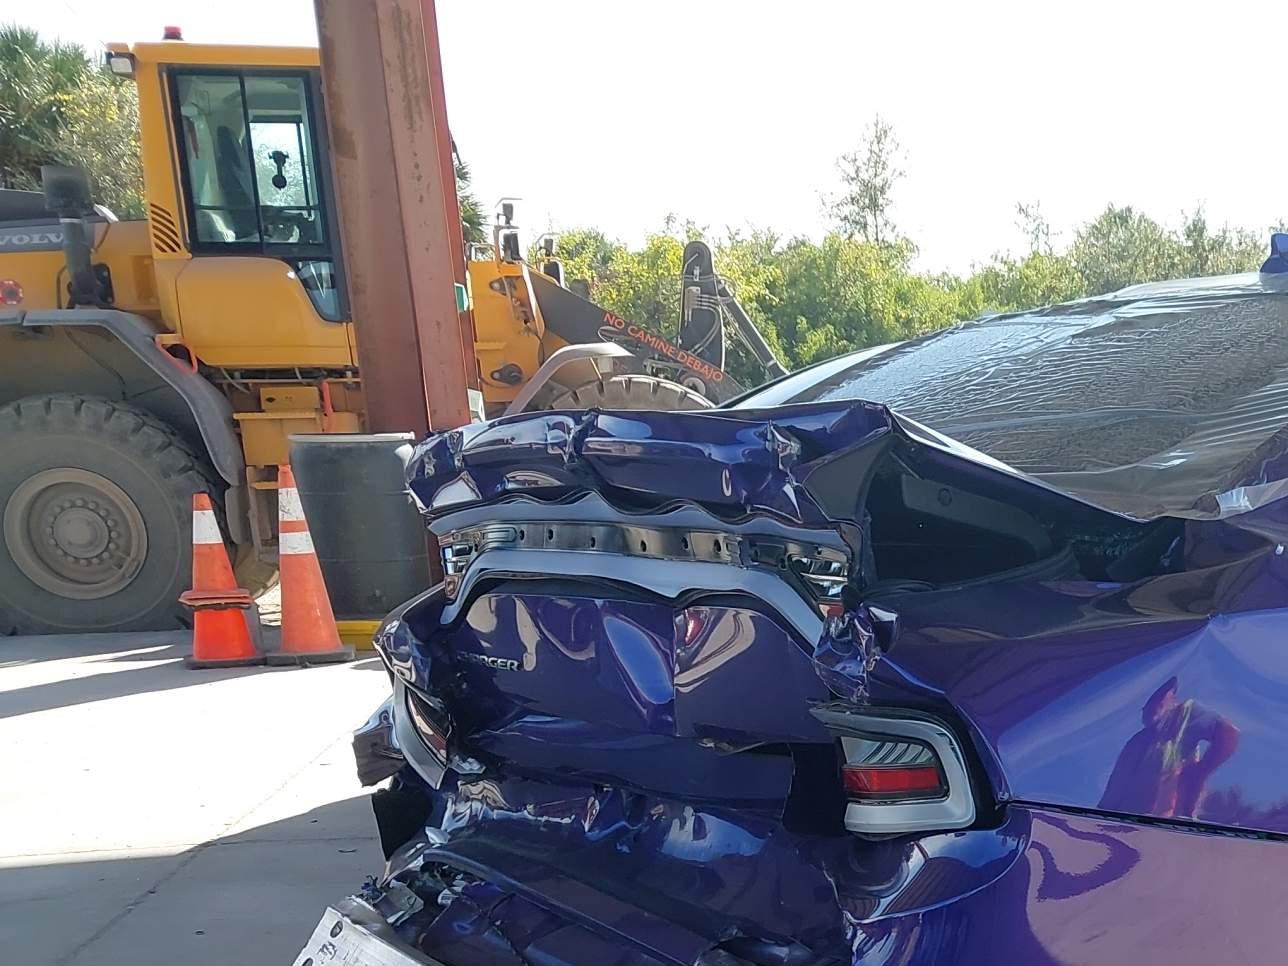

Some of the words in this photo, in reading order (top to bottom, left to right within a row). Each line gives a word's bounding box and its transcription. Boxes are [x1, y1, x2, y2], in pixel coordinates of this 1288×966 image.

[0, 232, 64, 245] VOLV
[604, 312, 625, 330] NO
[628, 326, 676, 357] CAMINE
[676, 352, 723, 382] DEBAJO
[456, 650, 519, 672] ARGER
